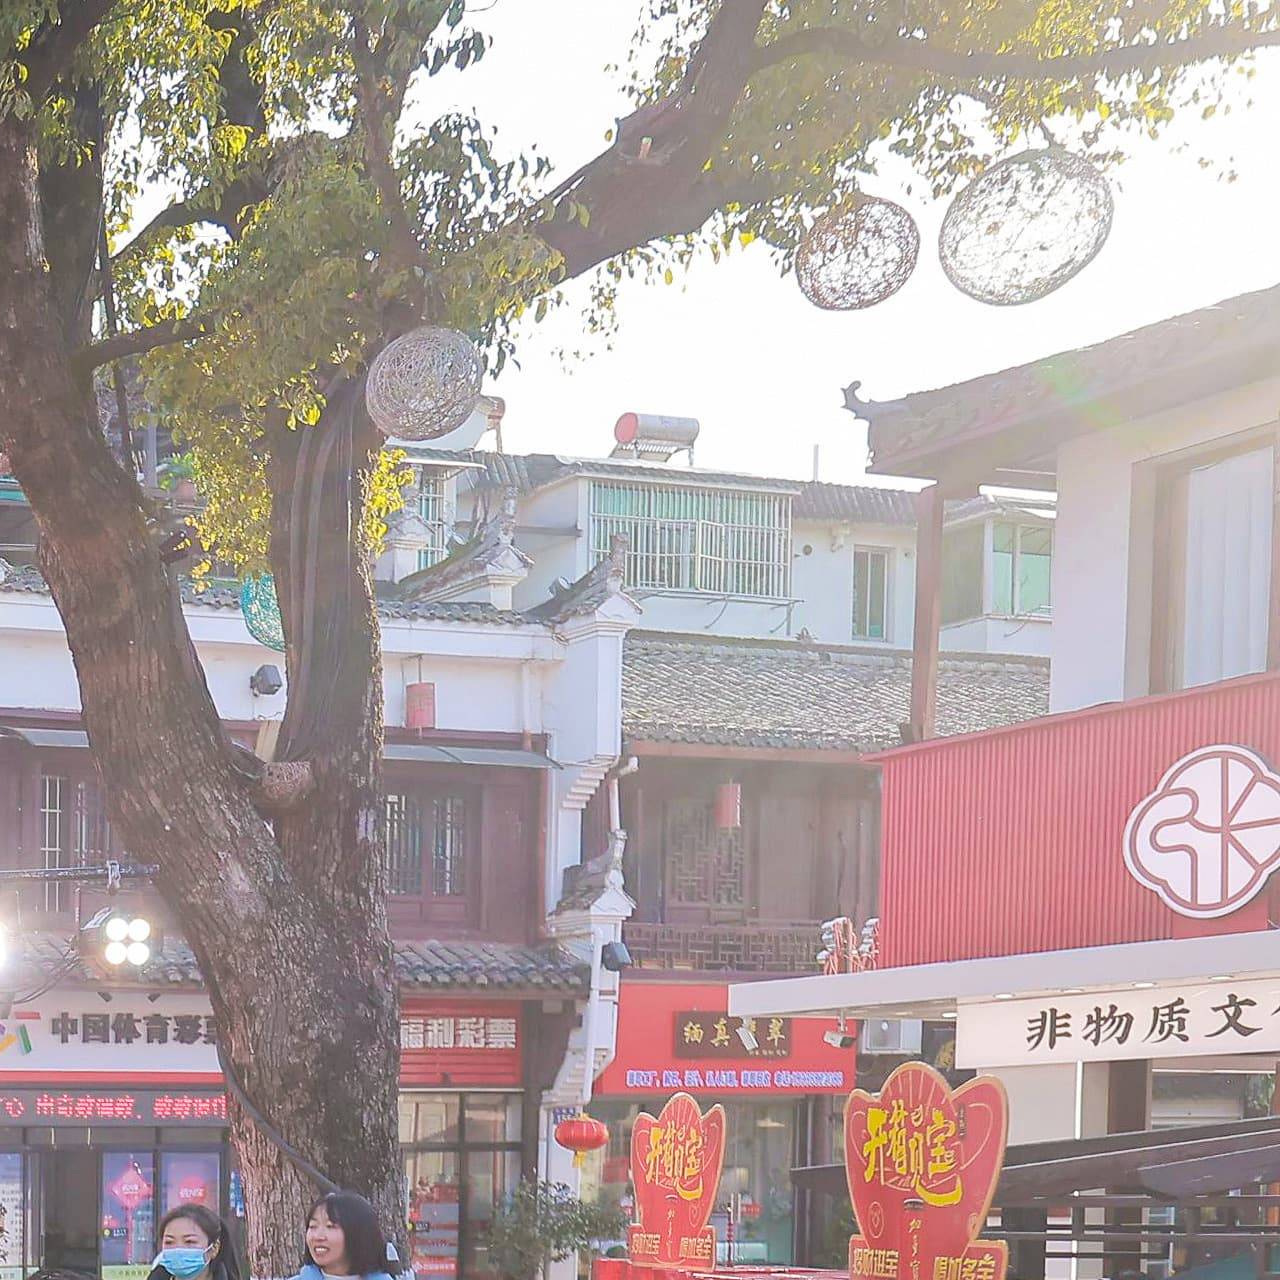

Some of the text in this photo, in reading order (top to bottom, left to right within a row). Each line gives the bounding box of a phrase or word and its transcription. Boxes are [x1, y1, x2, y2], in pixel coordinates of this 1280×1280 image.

[400, 1017, 516, 1049] 福利彩票
[1026, 993, 1280, 1051] 非物质文
[863, 1099, 963, 1206] 开箱见宝
